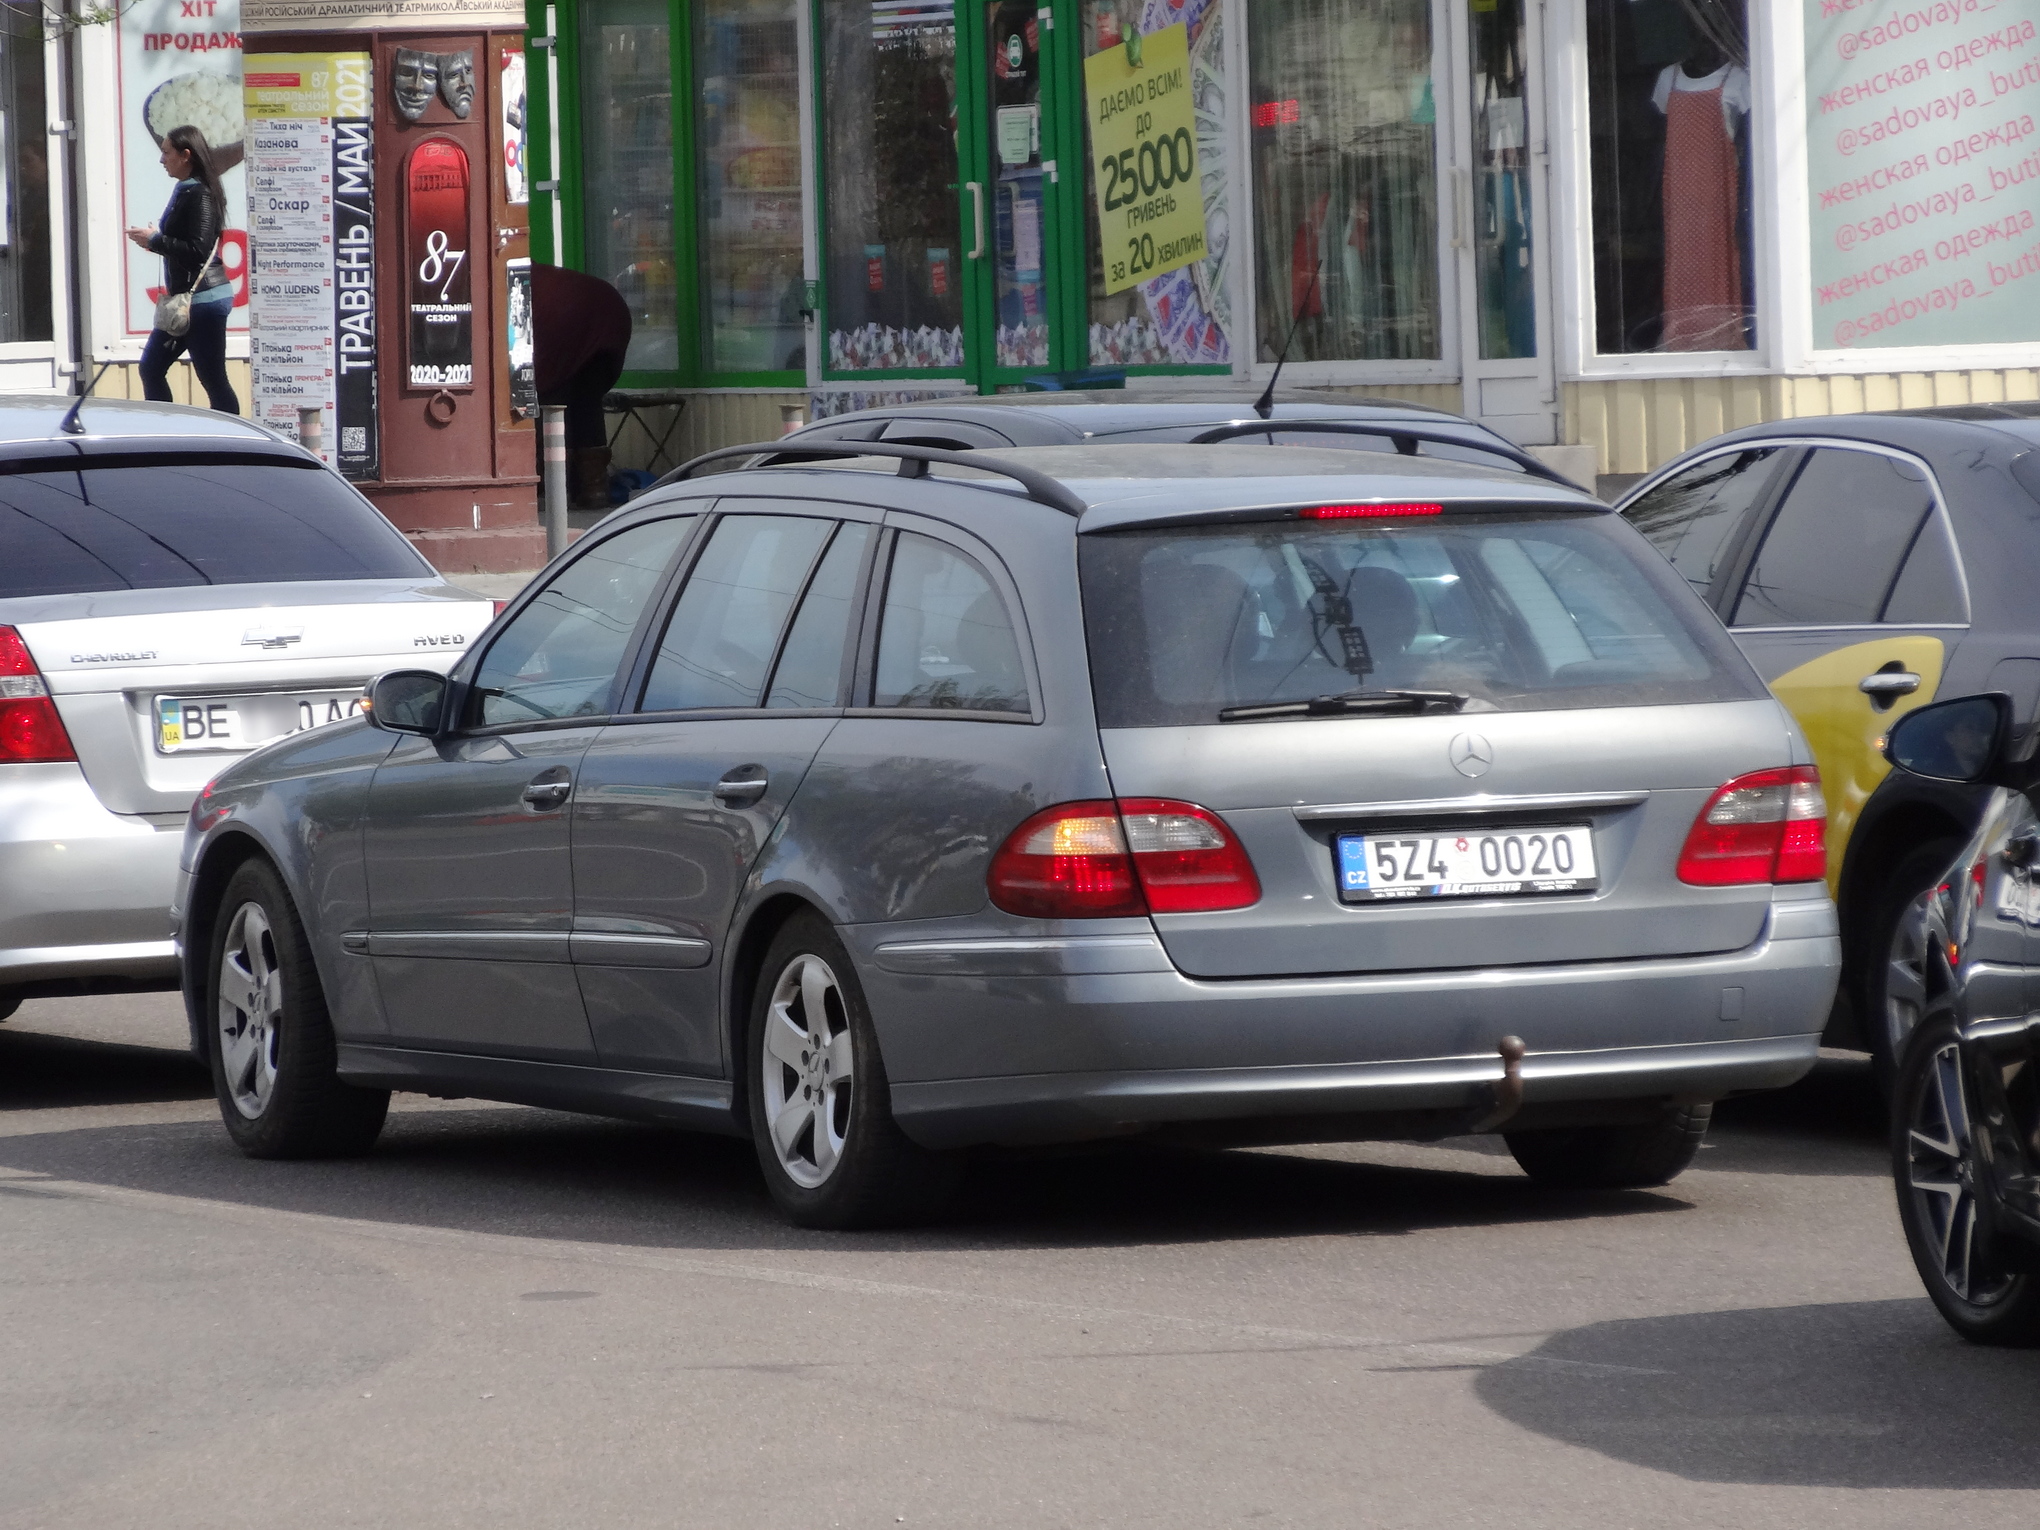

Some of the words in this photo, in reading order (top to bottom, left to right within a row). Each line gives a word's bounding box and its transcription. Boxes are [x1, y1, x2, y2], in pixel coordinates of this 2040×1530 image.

[181, 1, 218, 17] ХІТ
[265, 4, 317, 17] РОСІЙСЬКИЙ
[318, 2, 393, 16] ДРАМАТИЧНИЙ
[1818, 58, 1930, 114] женская
[1937, 20, 2036, 70] одежда
[311, 71, 329, 88] 87
[335, 59, 367, 117] 2021
[256, 91, 329, 104] театральний
[1100, 83, 1144, 125] ДАЄМО
[1149, 67, 1183, 101] ВСІМ!
[291, 101, 329, 113] сезон
[269, 122, 287, 131] Тиха
[289, 122, 303, 131] ніч
[1136, 111, 1152, 139] ДО
[255, 138, 299, 149] Казанова
[1102, 126, 1194, 212] 25000
[1818, 153, 1929, 210] женская
[1936, 115, 2035, 165] одежда
[256, 176, 275, 187] Селфі
[269, 198, 310, 213] Оскар
[1127, 193, 1177, 229] ГРИВЕНЬ
[257, 215, 276, 226] Селфі
[1111, 261, 1126, 282] за
[1128, 232, 1155, 276] 20
[1817, 249, 1929, 306] женская
[1934, 210, 2035, 261] одежда
[258, 260, 272, 270] Night
[273, 260, 326, 268] Performance
[420, 230, 466, 301] 87
[261, 285, 282, 295] HOMO
[284, 285, 321, 295] LUDENS
[337, 224, 372, 375] ТРАВЕНЬ
[411, 303, 472, 312] ТЕАТРАЛЬНИЙ
[425, 314, 458, 322] СЕЗОН
[261, 342, 293, 353] Тітонька
[271, 354, 304, 363] мільйон
[262, 373, 293, 383] Тітонька
[410, 364, 472, 383] 2020-2021
[271, 384, 304, 394] мільйон
[413, 634, 465, 646] AVEO
[70, 651, 159, 663] CHEVROLET
[182, 705, 231, 740] BE
[165, 731, 180, 742] UA
[1374, 838, 1449, 883] 5Z4
[1479, 833, 1575, 877] 0020
[1347, 871, 1368, 885] CZ
